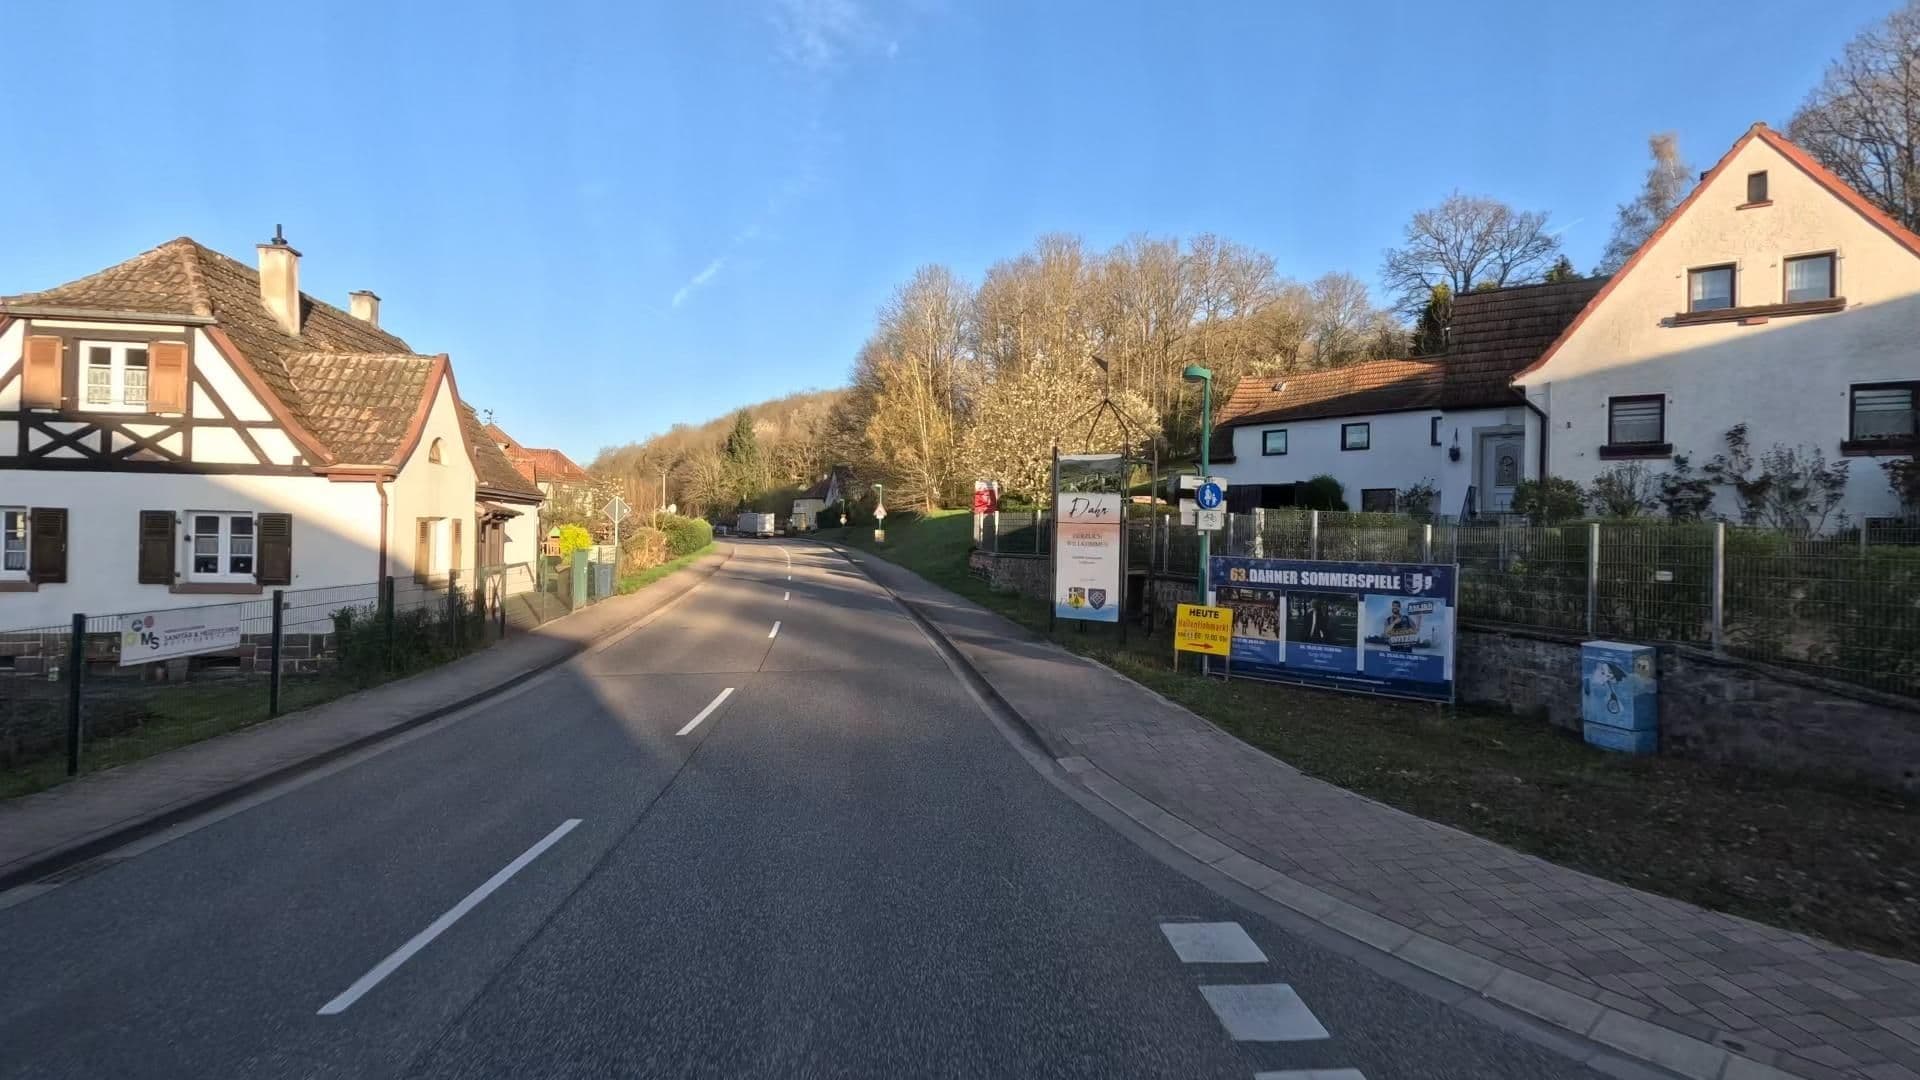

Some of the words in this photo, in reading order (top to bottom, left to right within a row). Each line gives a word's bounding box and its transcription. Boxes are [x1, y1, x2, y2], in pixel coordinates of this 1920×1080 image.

[1249, 568, 1298, 585] DAHNER
[1301, 570, 1401, 590] SOMMERSPIELE
[1189, 608, 1219, 619] HEUTE
